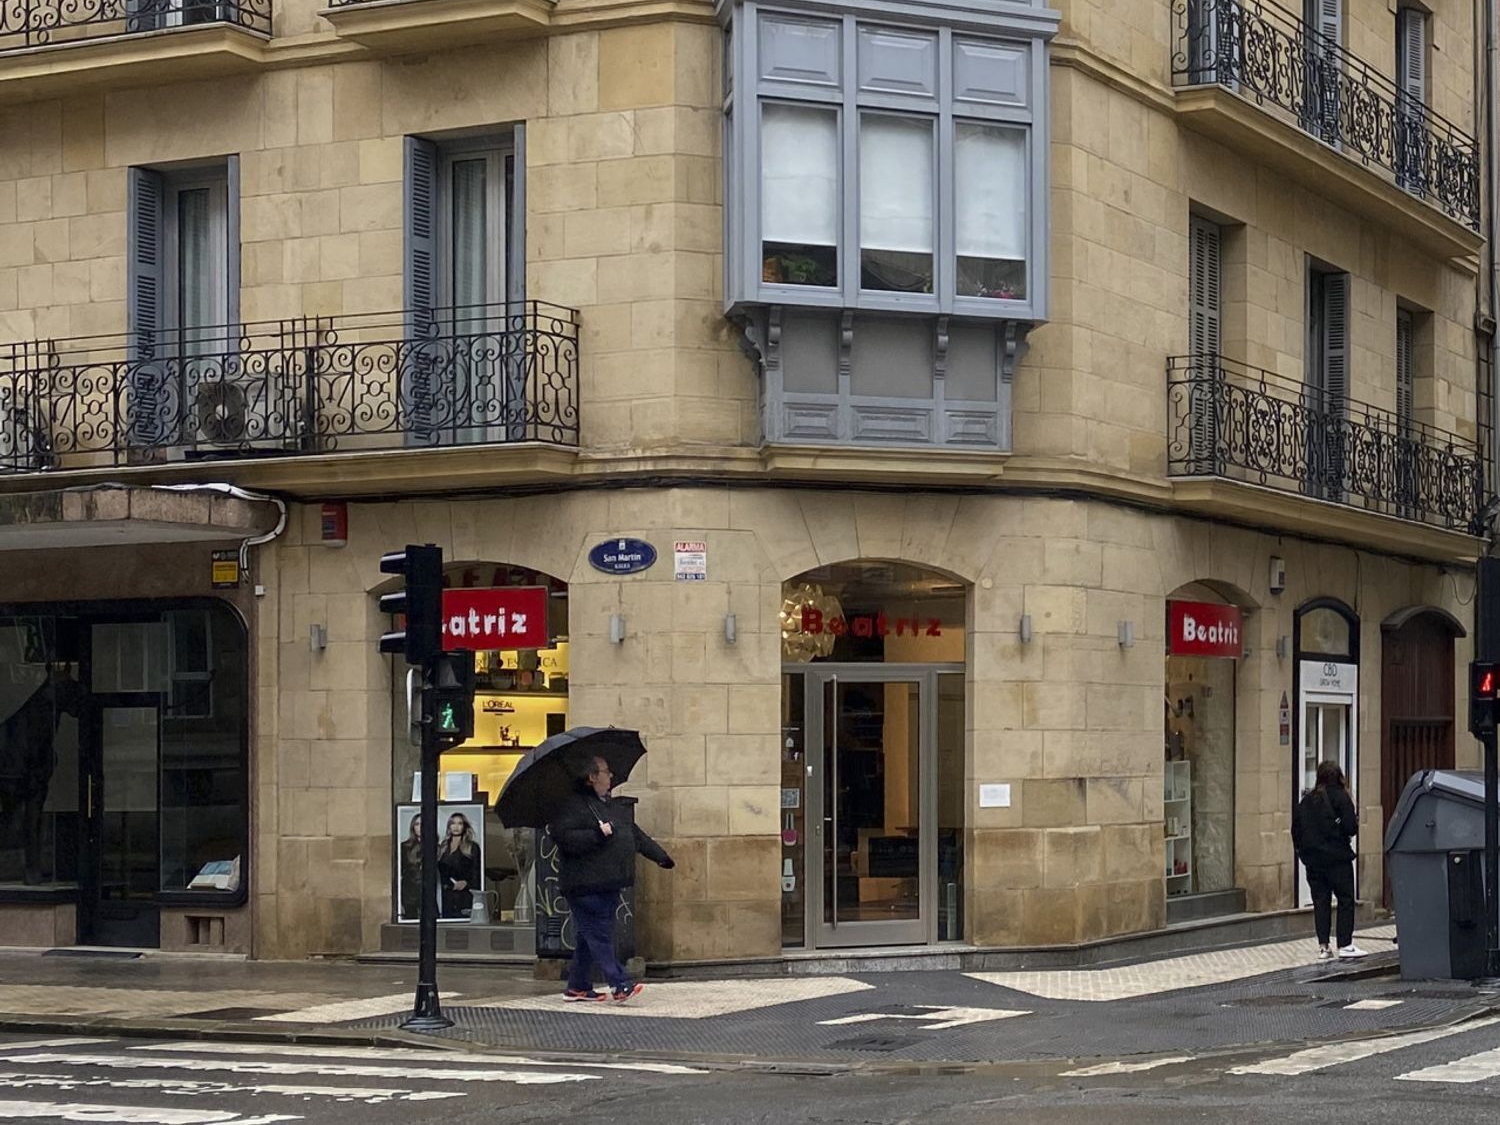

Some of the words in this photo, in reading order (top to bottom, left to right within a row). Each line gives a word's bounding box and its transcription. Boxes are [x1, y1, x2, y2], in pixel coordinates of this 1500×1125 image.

[676, 542, 705, 551] ALARMA
[603, 554, 617, 563] San
[618, 553, 641, 562] Martin
[801, 605, 941, 637] Beatriz
[1183, 613, 1239, 644] Beatriz
